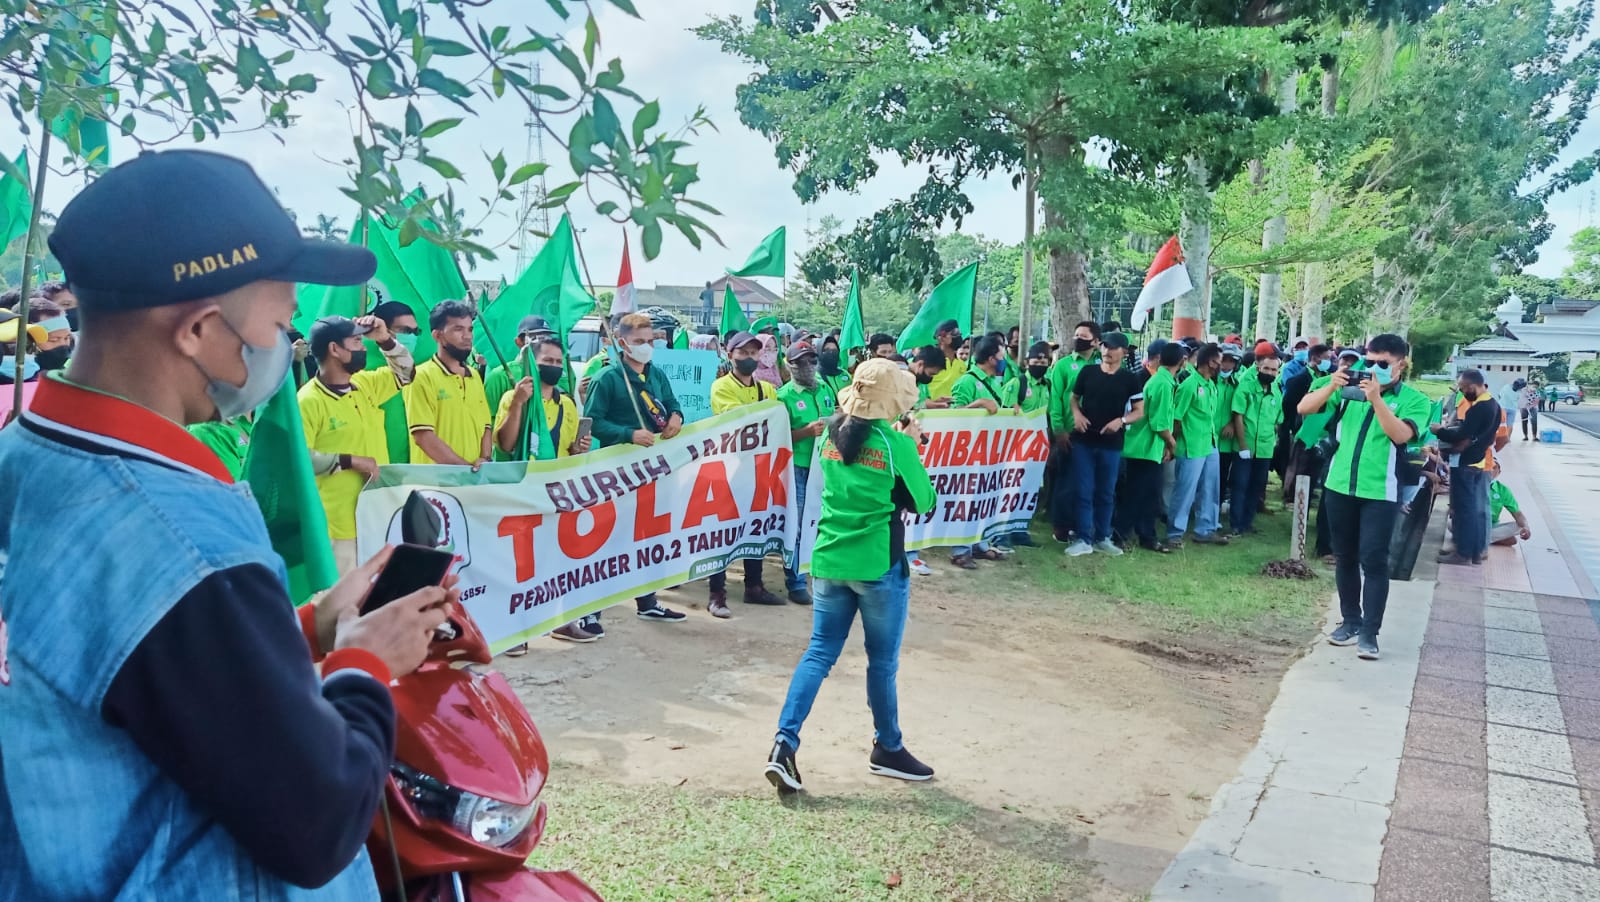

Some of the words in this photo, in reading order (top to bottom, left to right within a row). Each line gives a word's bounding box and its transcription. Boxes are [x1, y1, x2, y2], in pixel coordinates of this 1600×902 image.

[173, 243, 259, 282] PADLAN
[662, 363, 692, 381] OLAK
[917, 428, 1050, 469] MBALIKA
[545, 454, 672, 513] BURUH
[929, 467, 1025, 495] RMENAKER
[497, 446, 793, 584] TOLAK
[943, 496, 999, 522] TAHUN
[1000, 491, 1039, 514] 2015
[509, 553, 631, 615] PERMENAKER
[637, 539, 682, 569] NO.2
[688, 521, 746, 554] TAHUN
[749, 512, 786, 536] 2022
